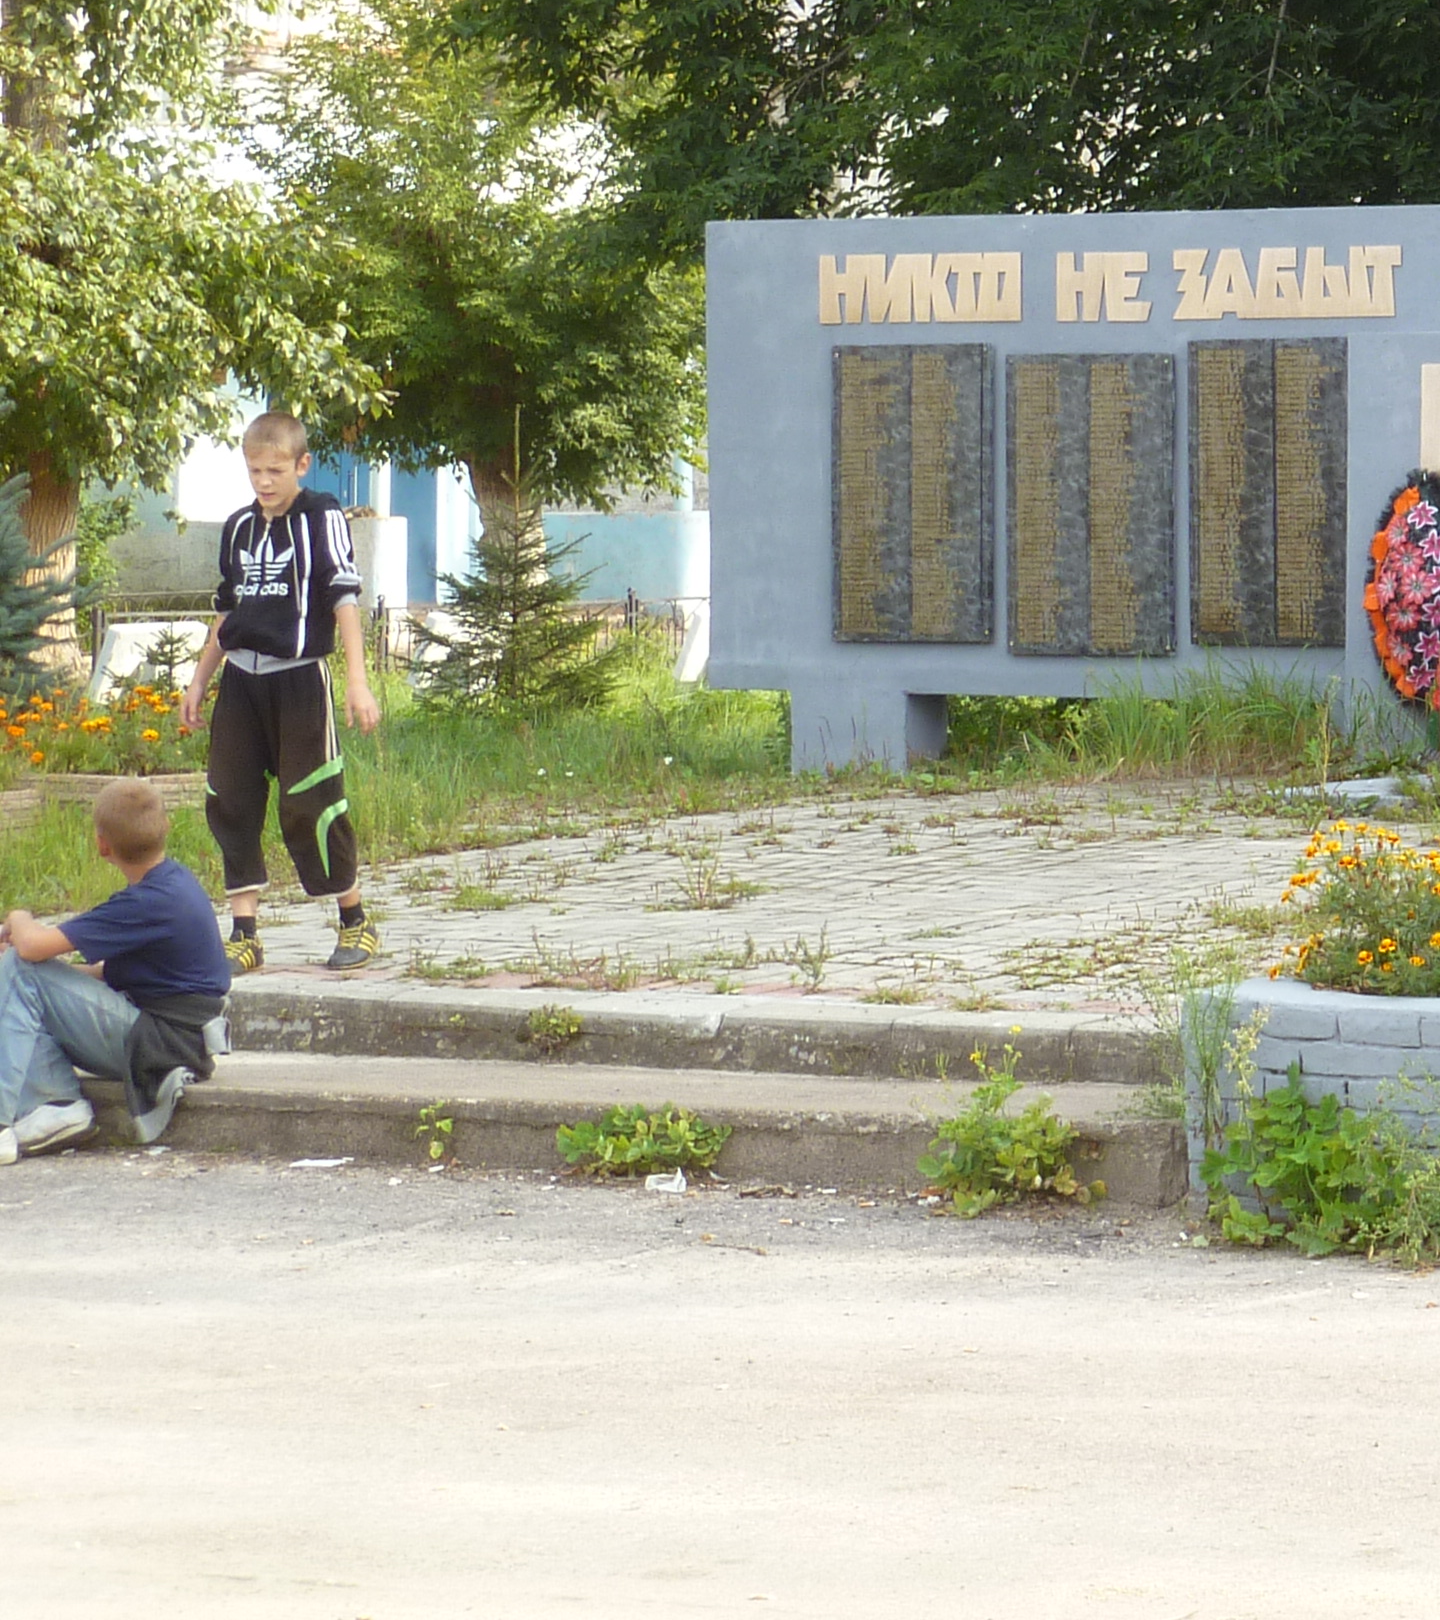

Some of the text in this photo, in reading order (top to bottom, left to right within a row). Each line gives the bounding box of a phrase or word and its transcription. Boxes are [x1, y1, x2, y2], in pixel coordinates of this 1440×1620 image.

[819, 245, 1403, 325] НИКТО НЕ ЗАБЫТ
